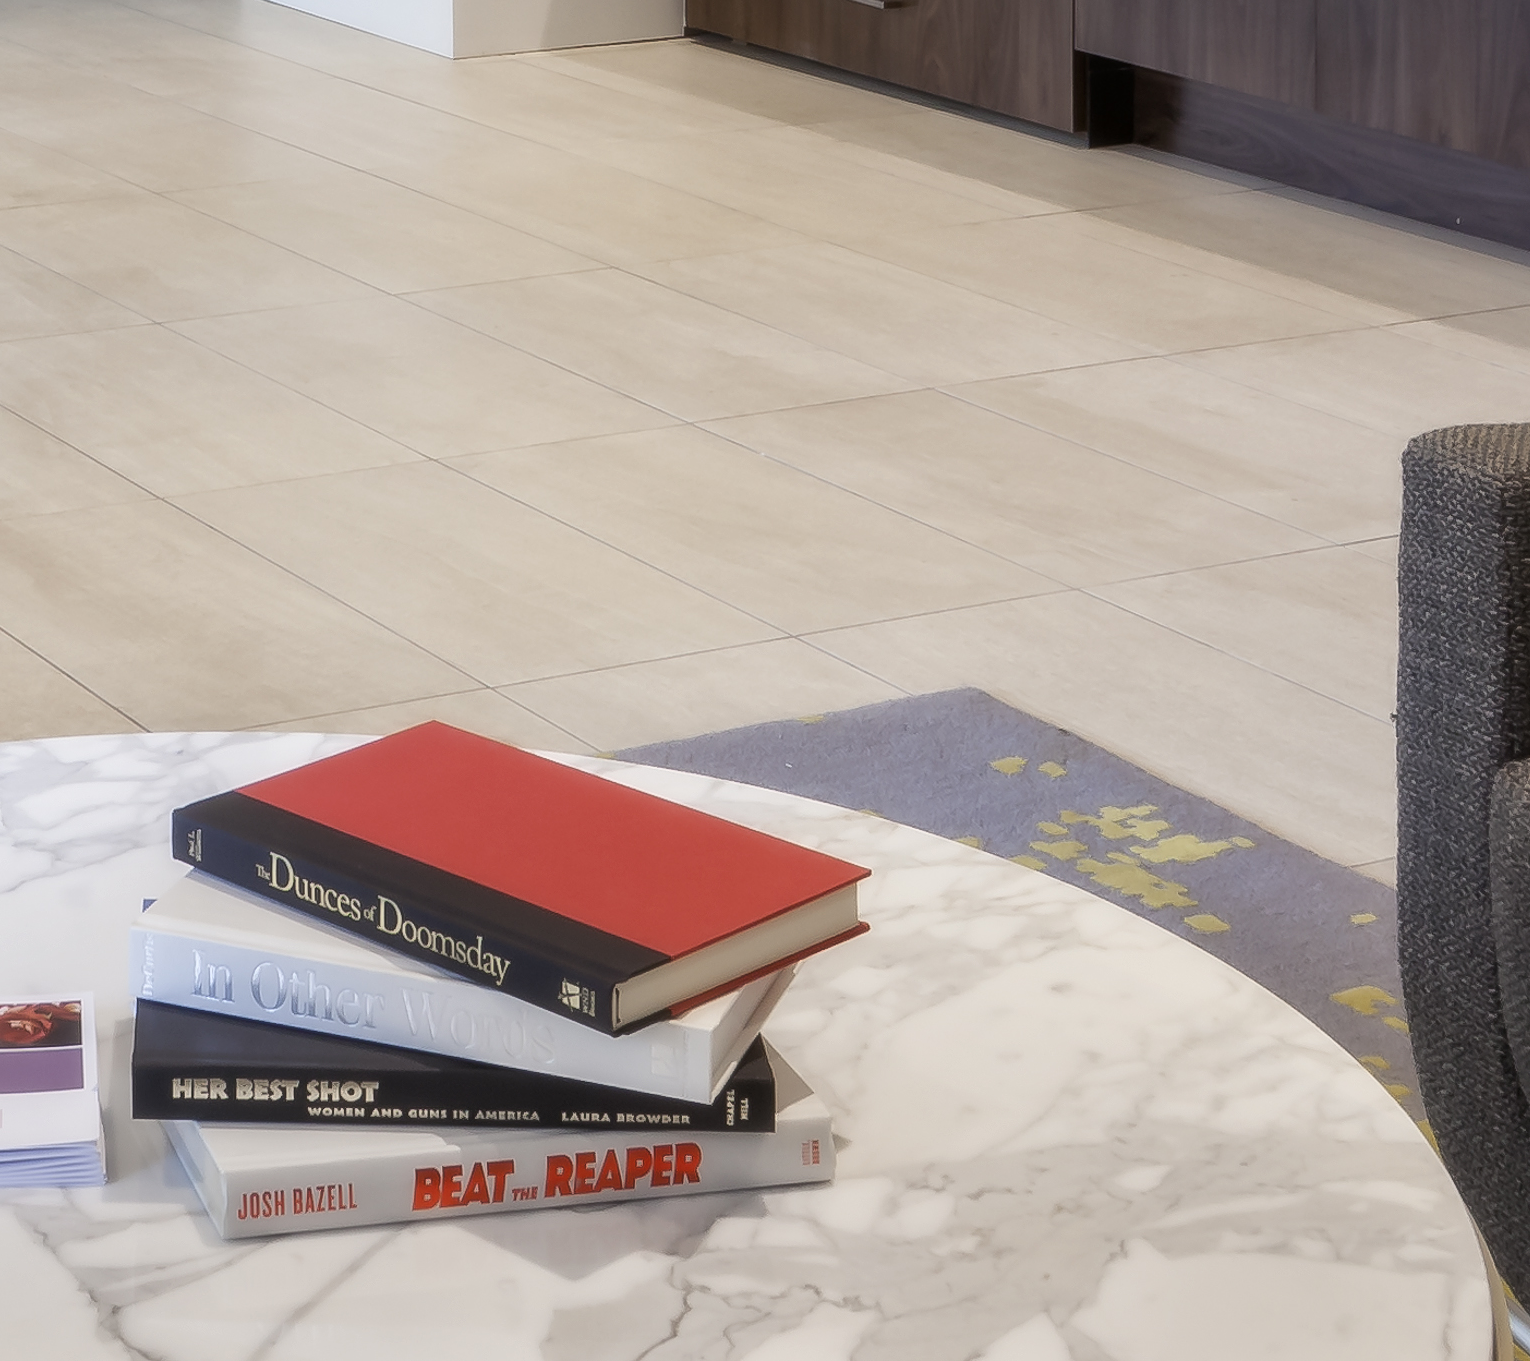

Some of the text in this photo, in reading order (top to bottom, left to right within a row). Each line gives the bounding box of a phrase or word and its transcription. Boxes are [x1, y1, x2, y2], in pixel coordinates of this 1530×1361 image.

[255, 851, 511, 986] The Dunces of Doomsday
[191, 948, 556, 1065] In Other Words
[171, 1077, 379, 1103] HER BEST SHOT
[726, 1089, 736, 1126] CHAPEL
[307, 1106, 540, 1121] WOMEN AND GUNS IN AMERICA
[561, 1112, 691, 1125] LAURA BROWDER
[740, 1097, 749, 1121] HILL
[411, 1141, 703, 1212] BEAT THE REAPER
[237, 1183, 358, 1220] JOSH BAZELL
